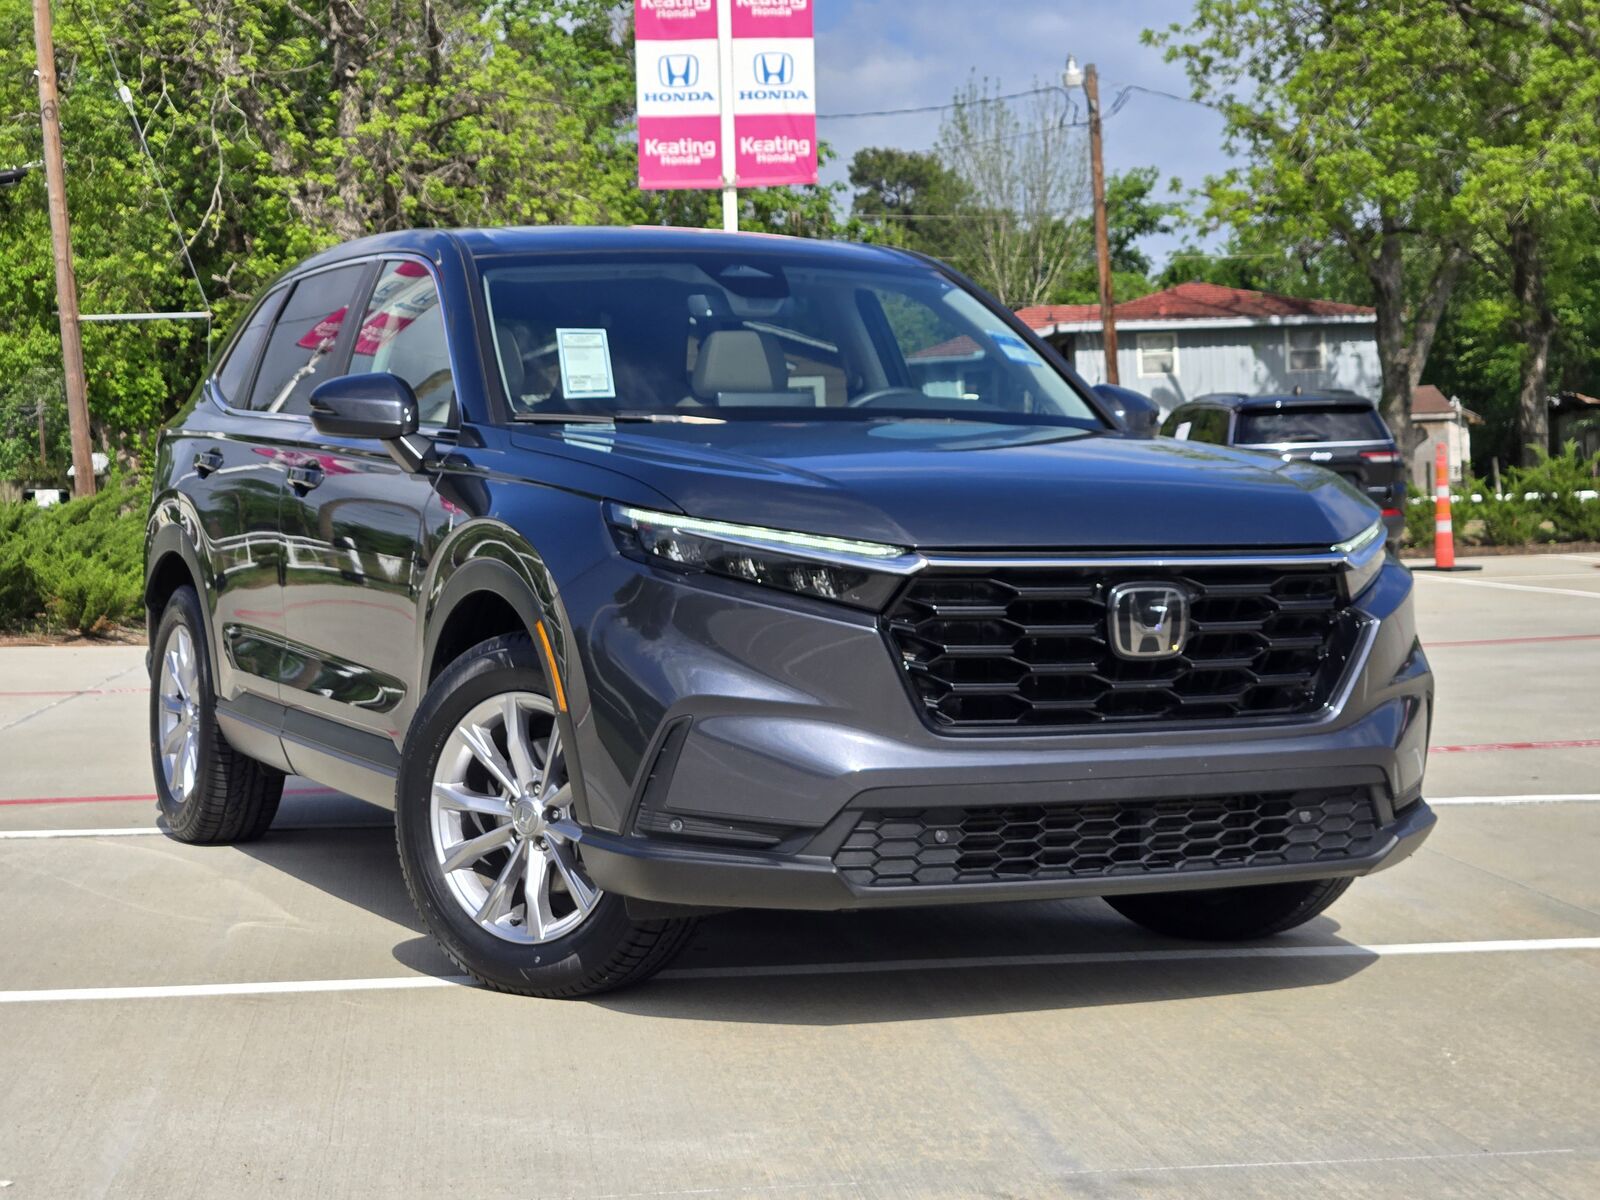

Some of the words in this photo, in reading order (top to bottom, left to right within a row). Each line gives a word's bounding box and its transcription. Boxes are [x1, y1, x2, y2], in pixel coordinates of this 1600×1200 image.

[656, 7, 697, 19] Honda
[751, 5, 792, 17] Honda
[644, 91, 715, 101] HONDA
[740, 89, 809, 100] HONDA
[644, 137, 716, 159] Keating
[740, 135, 811, 158] Keating
[660, 154, 702, 166] Honda
[756, 152, 797, 164] Honda
